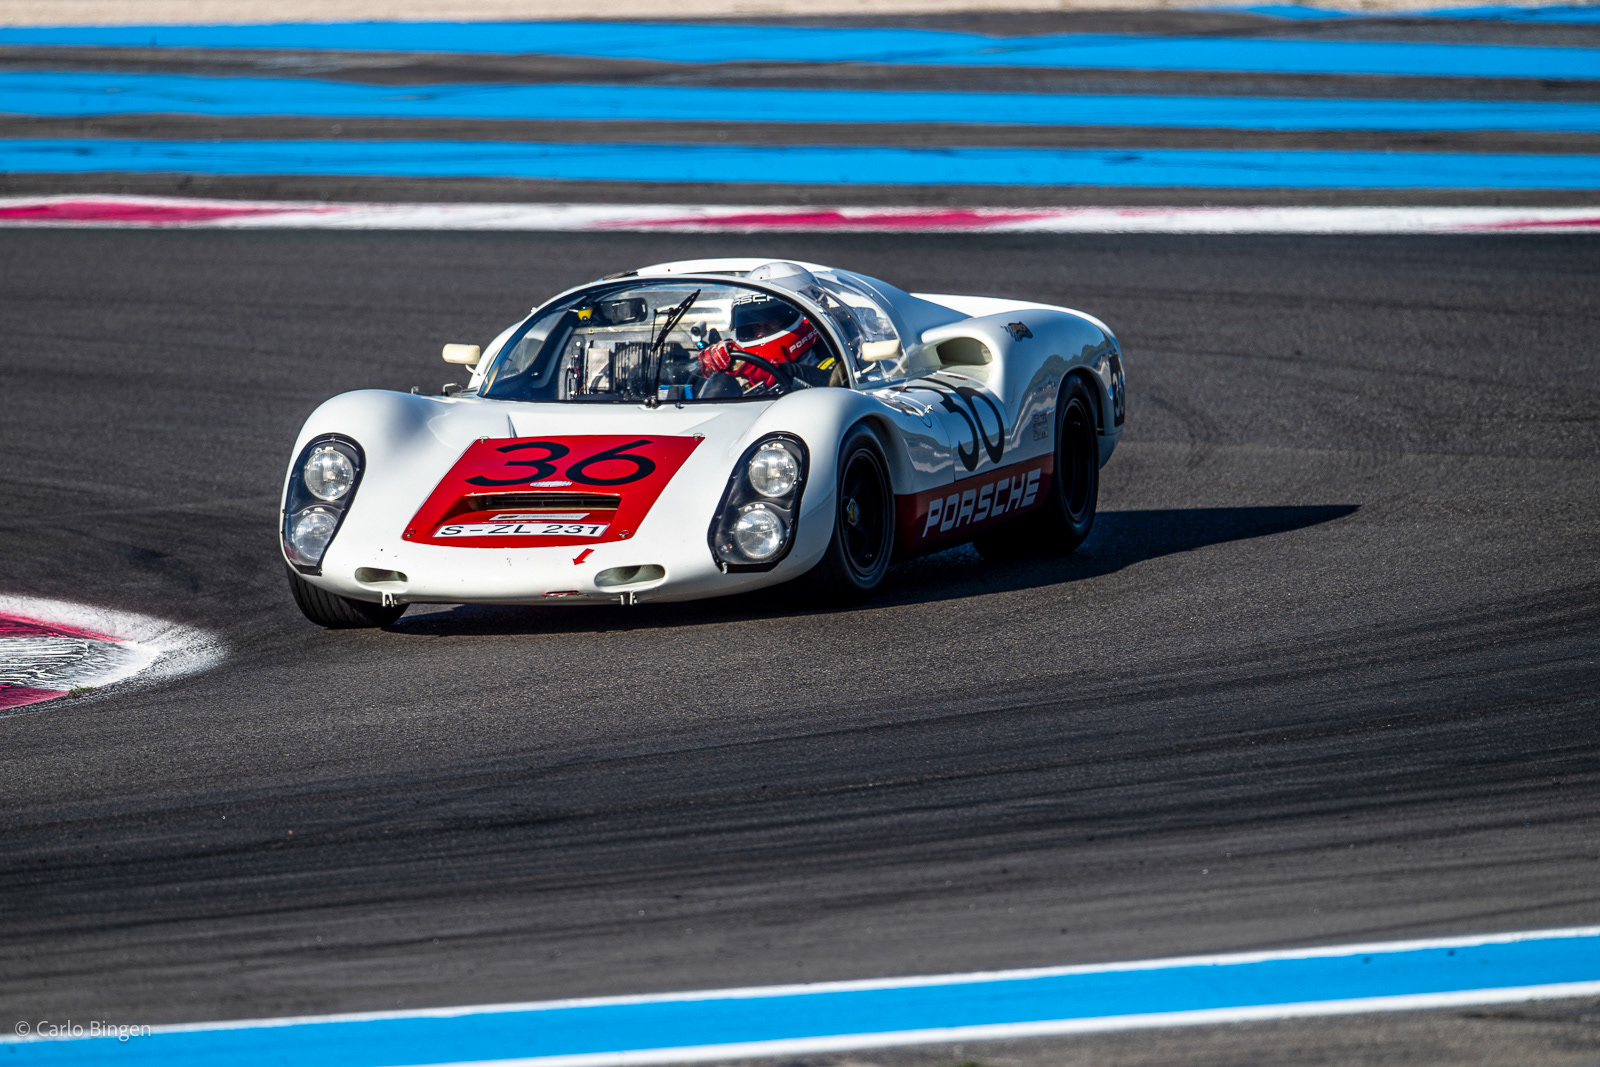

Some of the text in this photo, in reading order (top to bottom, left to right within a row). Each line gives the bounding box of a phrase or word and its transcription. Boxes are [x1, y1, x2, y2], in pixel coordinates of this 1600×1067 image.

[465, 439, 656, 487] 36
[922, 468, 1042, 538] PORSCHE
[541, 524, 600, 535] 231
